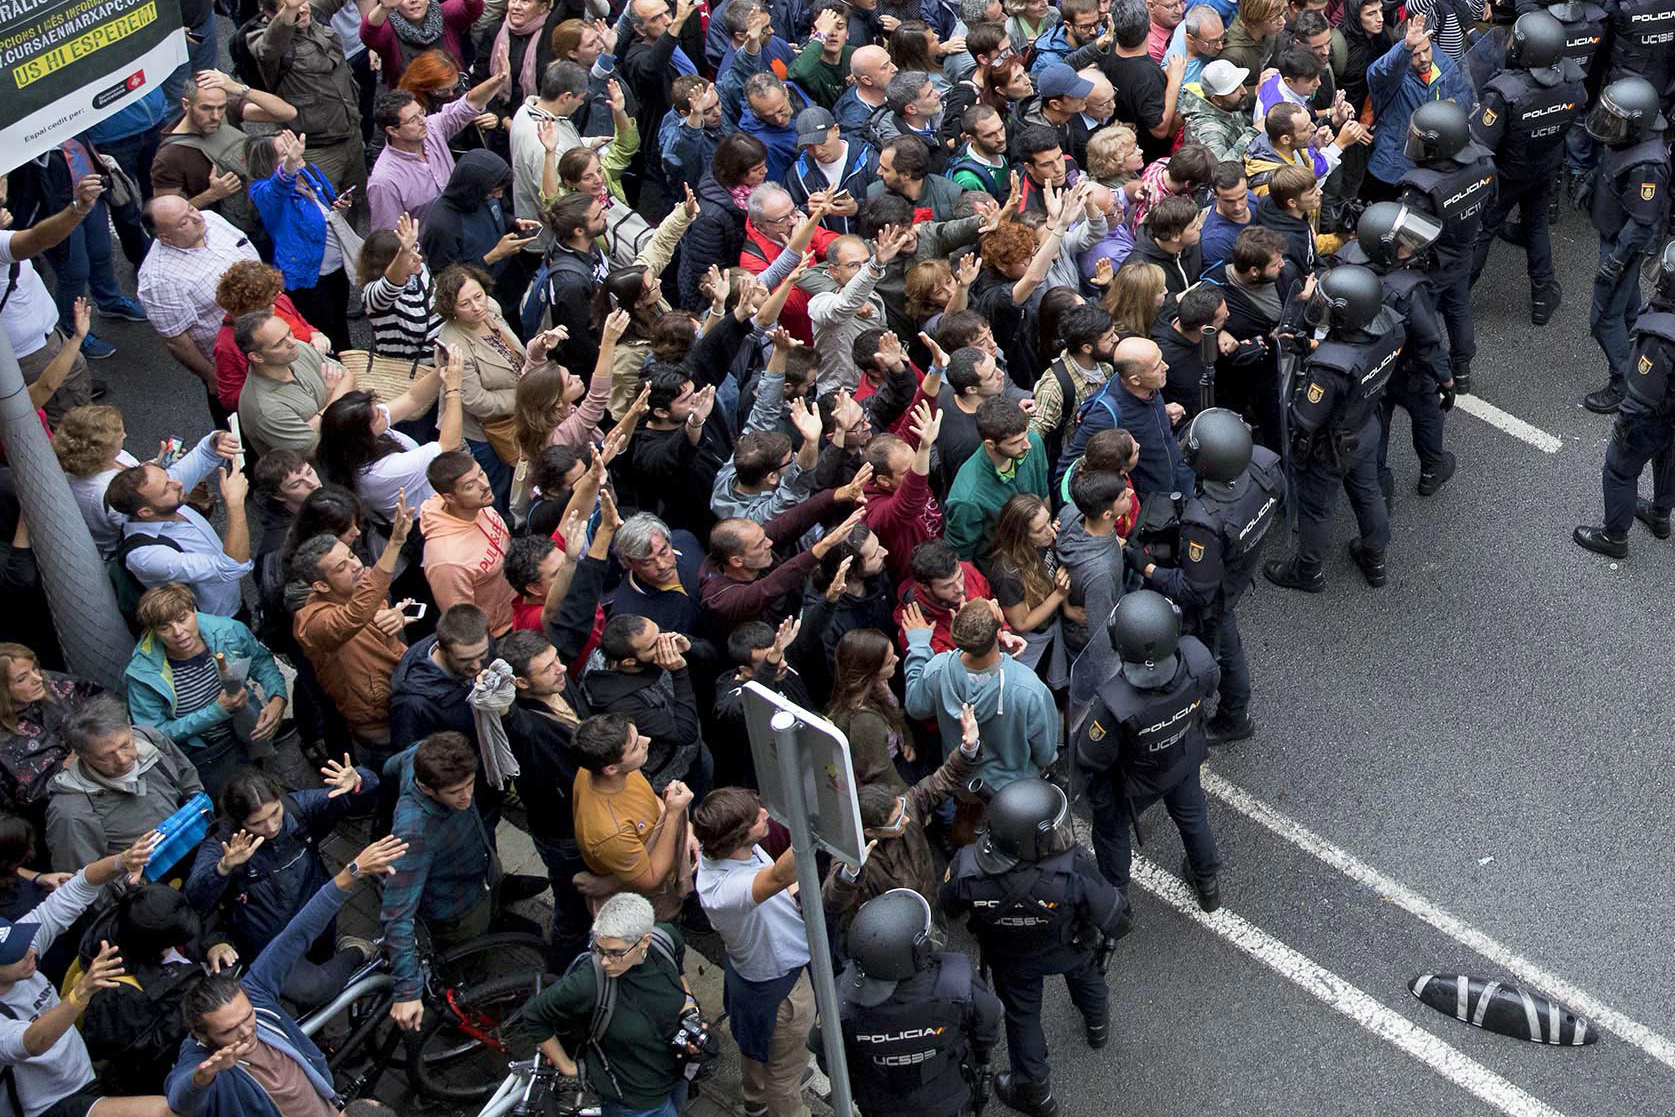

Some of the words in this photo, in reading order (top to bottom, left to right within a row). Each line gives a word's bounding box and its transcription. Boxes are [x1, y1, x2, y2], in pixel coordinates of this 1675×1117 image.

[44, 14, 65, 32] MÉS
[1566, 35, 1596, 47] LICIA
[16, 61, 42, 85] US
[47, 48, 66, 72] HI
[47, 115, 68, 131] cedit
[69, 106, 85, 123] per:
[1522, 103, 1569, 121] POLICIA
[1443, 179, 1487, 209] POLICIA
[1361, 350, 1398, 385] POLICIA
[1239, 497, 1277, 541] POLICIA
[1138, 702, 1197, 736] POLICIA
[856, 1027, 936, 1043] POLICIA
